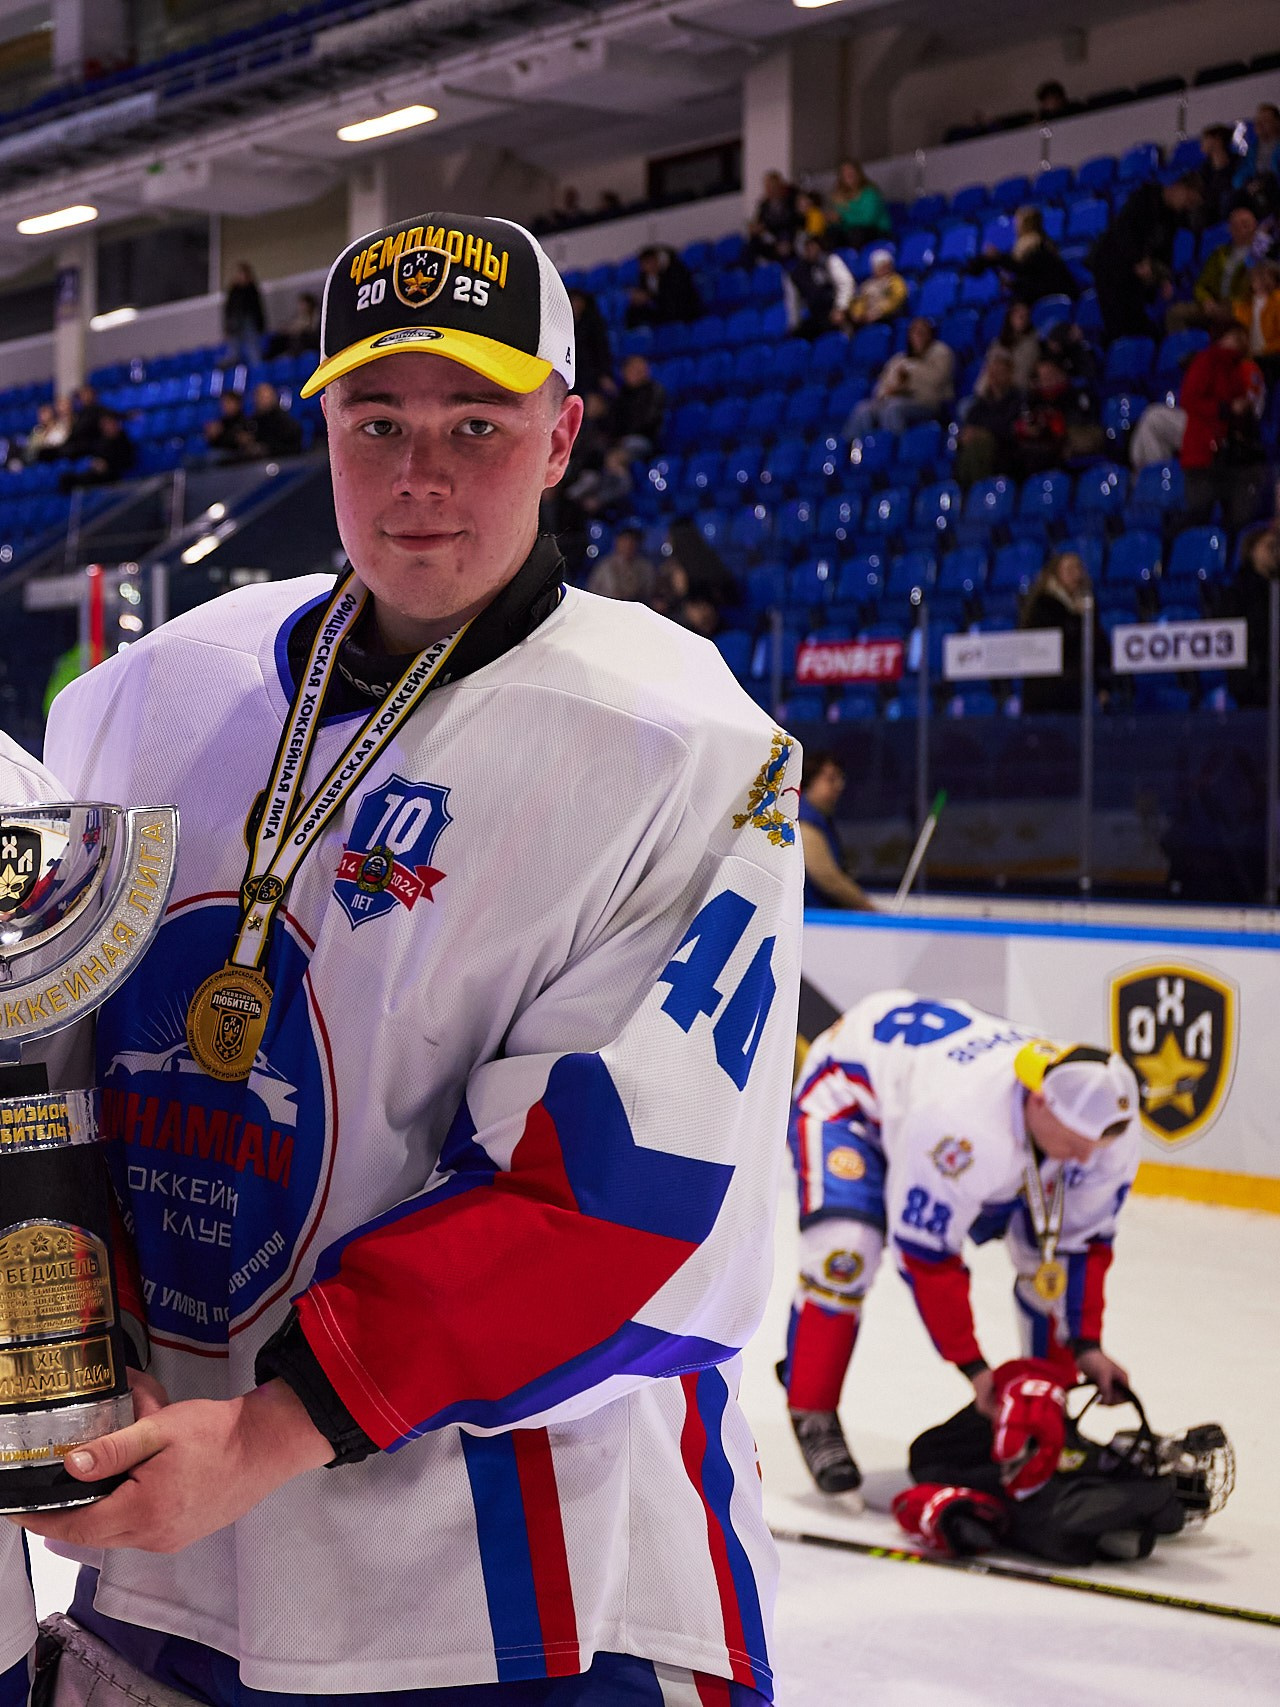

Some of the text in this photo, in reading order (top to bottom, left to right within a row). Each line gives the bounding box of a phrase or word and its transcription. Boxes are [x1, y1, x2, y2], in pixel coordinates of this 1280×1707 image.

[350, 226, 509, 289] ЧЕМПИОНЫ
[356, 275, 490, 311] 20 25
[308, 594, 357, 688] ОФИЦЕРСКАЯ
[797, 643, 901, 677] FONBET
[1124, 627, 1236, 662] согаз
[277, 692, 317, 793] ХОККЕЙНАЯ
[294, 738, 376, 846] ОФИЦЕРСКАЯ
[371, 641, 447, 736] ХОККЕЙНАЯ
[263, 795, 286, 840] ЛИГА
[366, 793, 433, 856] 10
[128, 819, 165, 917] ЛИГА
[351, 893, 374, 912] ЛЕТ
[190, 978, 214, 1014] ЧЕМПИОНАТ
[212, 993, 261, 1014] ЛЮБИТЕЛЬ
[1128, 977, 1213, 1060] ОХЛ
[902, 1184, 952, 1236] 88
[160, 1286, 209, 1326] УМВД
[36, 1351, 62, 1371] ХК
[74, 1364, 110, 1388] ГАИ»
